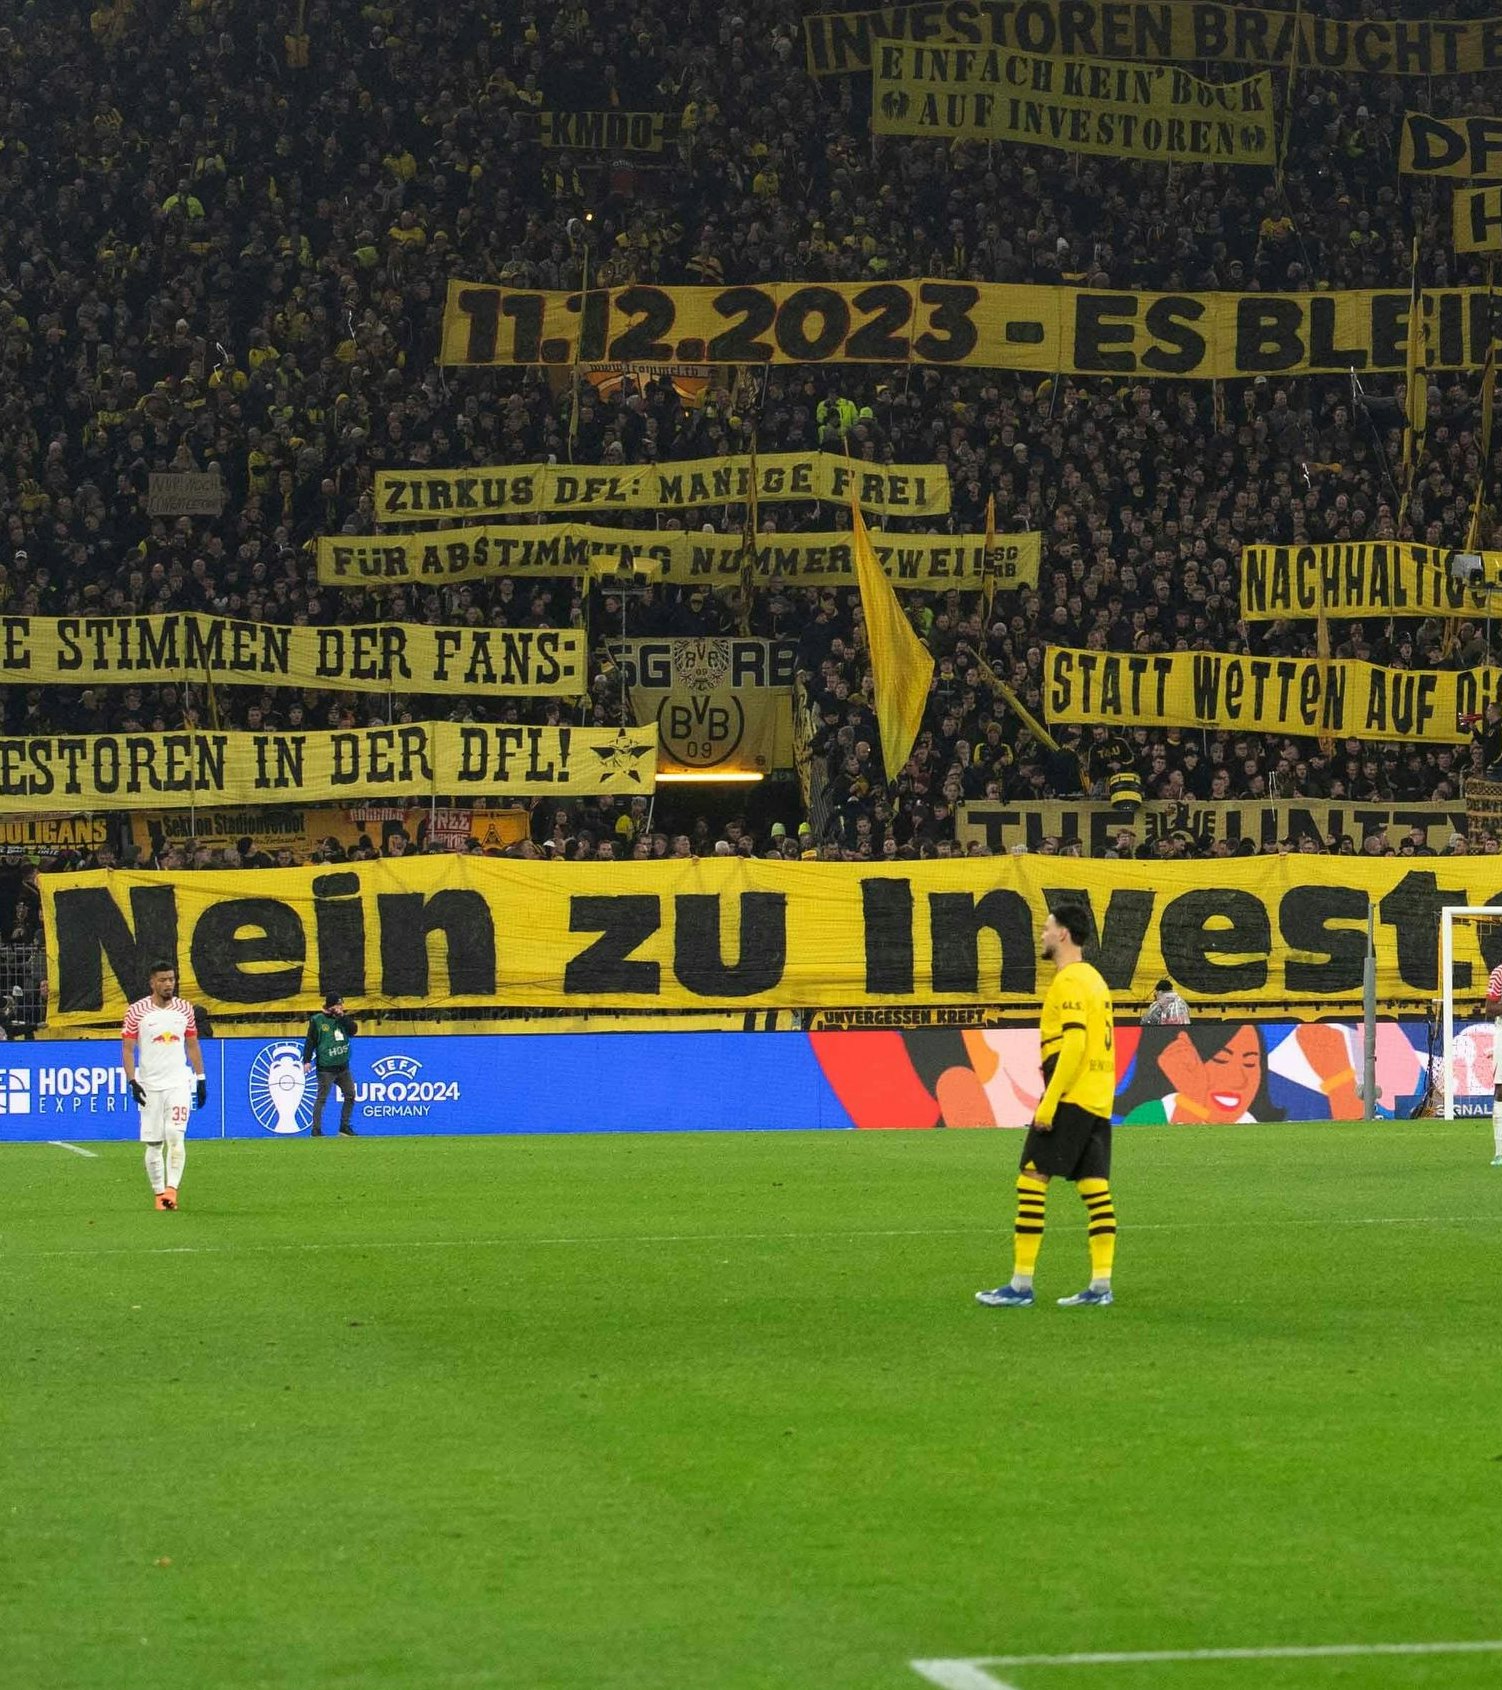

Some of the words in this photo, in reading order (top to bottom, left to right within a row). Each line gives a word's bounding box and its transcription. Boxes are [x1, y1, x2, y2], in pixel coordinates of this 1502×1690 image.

[811, 0, 1172, 69] INVESTOREN
[1194, 3, 1463, 74] BRAUCHT
[880, 46, 1053, 93] EINFACH
[918, 92, 995, 128] AUF
[1009, 97, 1236, 155] INVESTOREN
[458, 283, 979, 365] 11.12.2023
[1073, 294, 1207, 372] ES
[383, 475, 534, 511] ZIRKUS
[554, 475, 641, 505] DFL:
[832, 467, 927, 506] FREI
[691, 544, 854, 577] NUMMER
[58, 614, 293, 674] STIMMEN
[316, 626, 413, 680] DER
[433, 628, 577, 686] FANS:
[1052, 650, 1173, 718] STATT
[1366, 667, 1438, 736] AUF
[670, 695, 730, 743] BVB
[254, 735, 307, 789] IN
[330, 727, 434, 784] DER
[457, 728, 572, 783] DFL!
[687, 741, 713, 760] 09
[54, 871, 497, 1012] Nein
[563, 892, 787, 997] zu
[824, 1010, 932, 1025] UNVERGESSEN
[374, 1058, 419, 1077] UEFA
[363, 1104, 431, 1118] GERMANY
[1436, 1103, 1494, 1117] SGNAL
